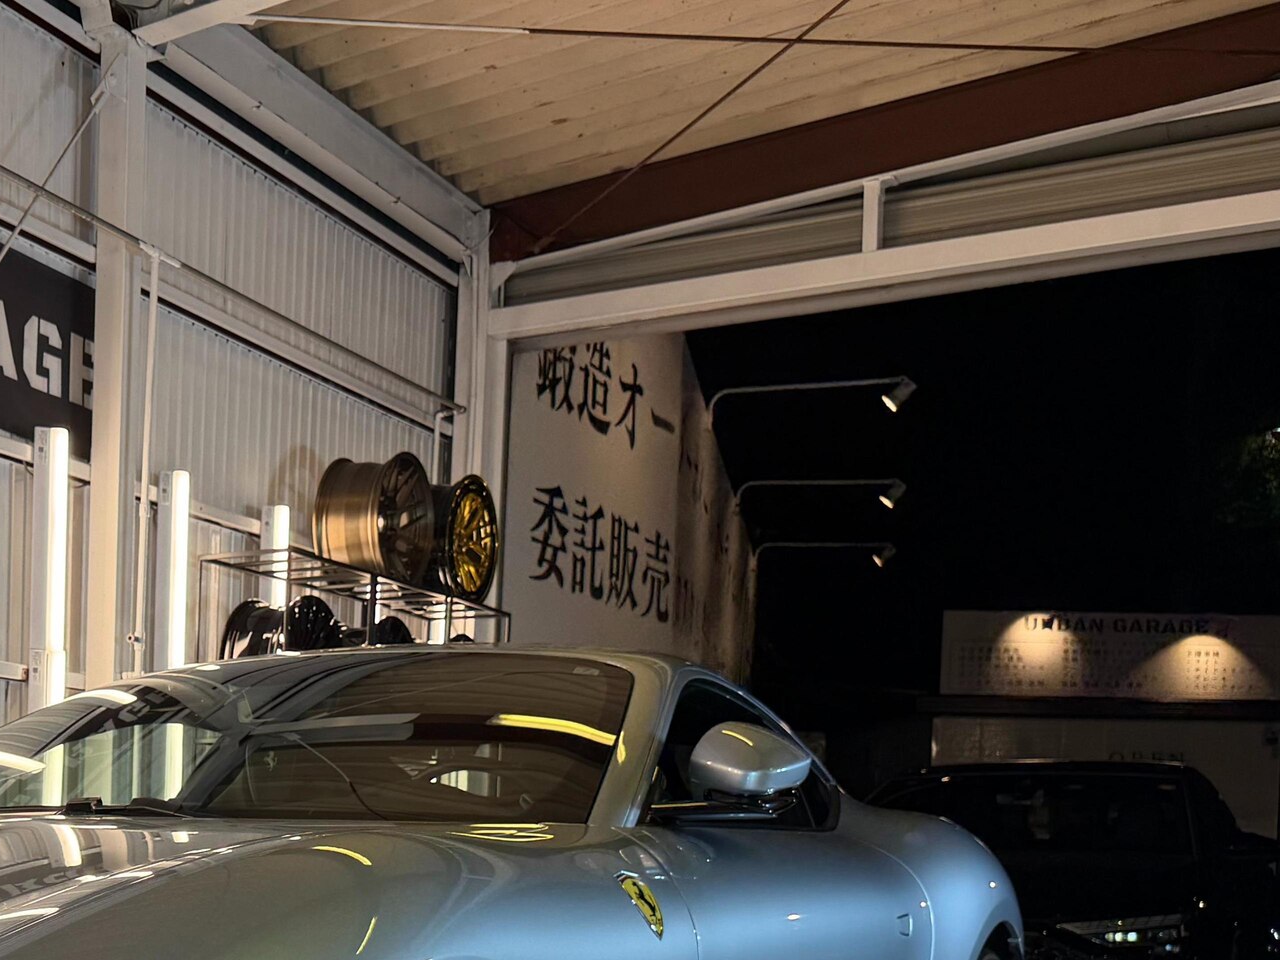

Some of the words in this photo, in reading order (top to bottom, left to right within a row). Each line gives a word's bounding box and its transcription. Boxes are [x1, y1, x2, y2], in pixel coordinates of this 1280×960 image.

[529, 485, 671, 623] 委託販売
[1023, 614, 1104, 634] UBAN
[1113, 616, 1210, 635] GARAGE
